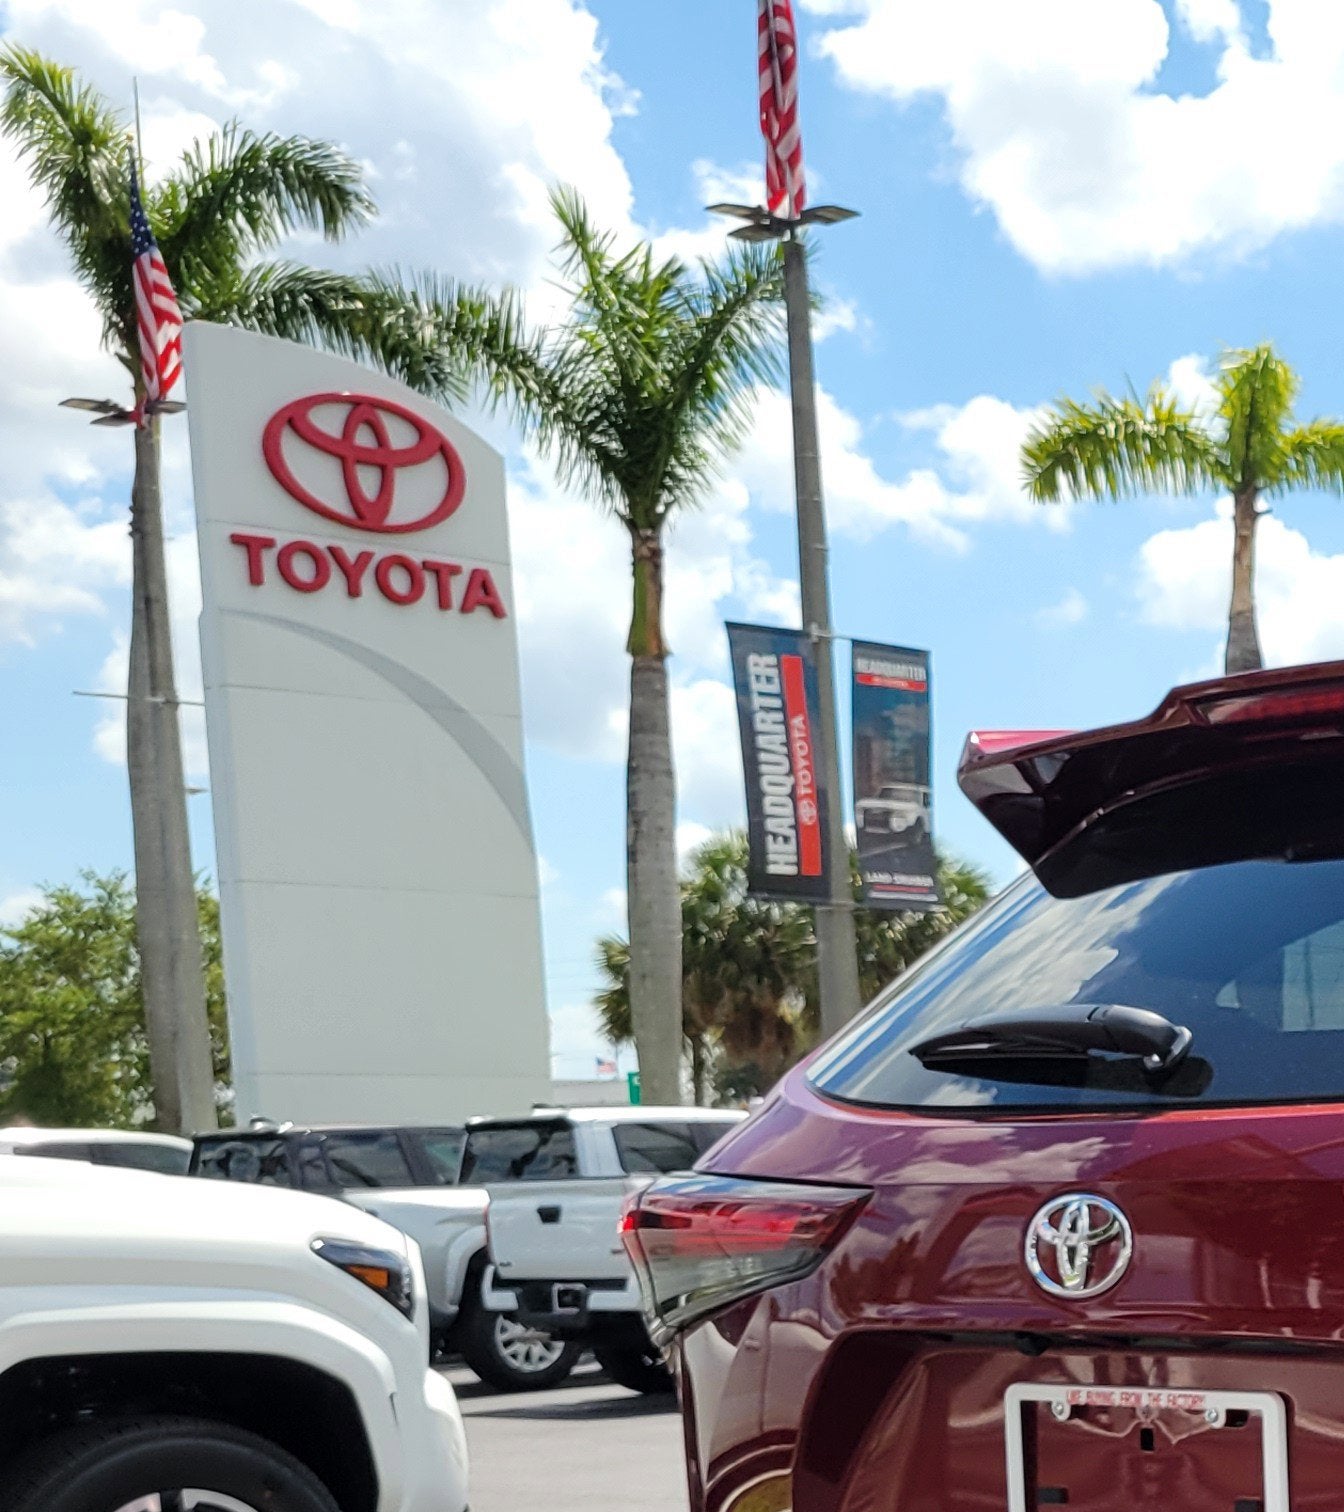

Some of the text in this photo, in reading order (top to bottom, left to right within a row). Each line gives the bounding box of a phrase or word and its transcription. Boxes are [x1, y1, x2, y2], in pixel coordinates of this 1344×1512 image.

[230, 533, 507, 618] TOYOTA
[747, 652, 799, 875] HEADQUARTER
[790, 713, 818, 796] TOYOTA
